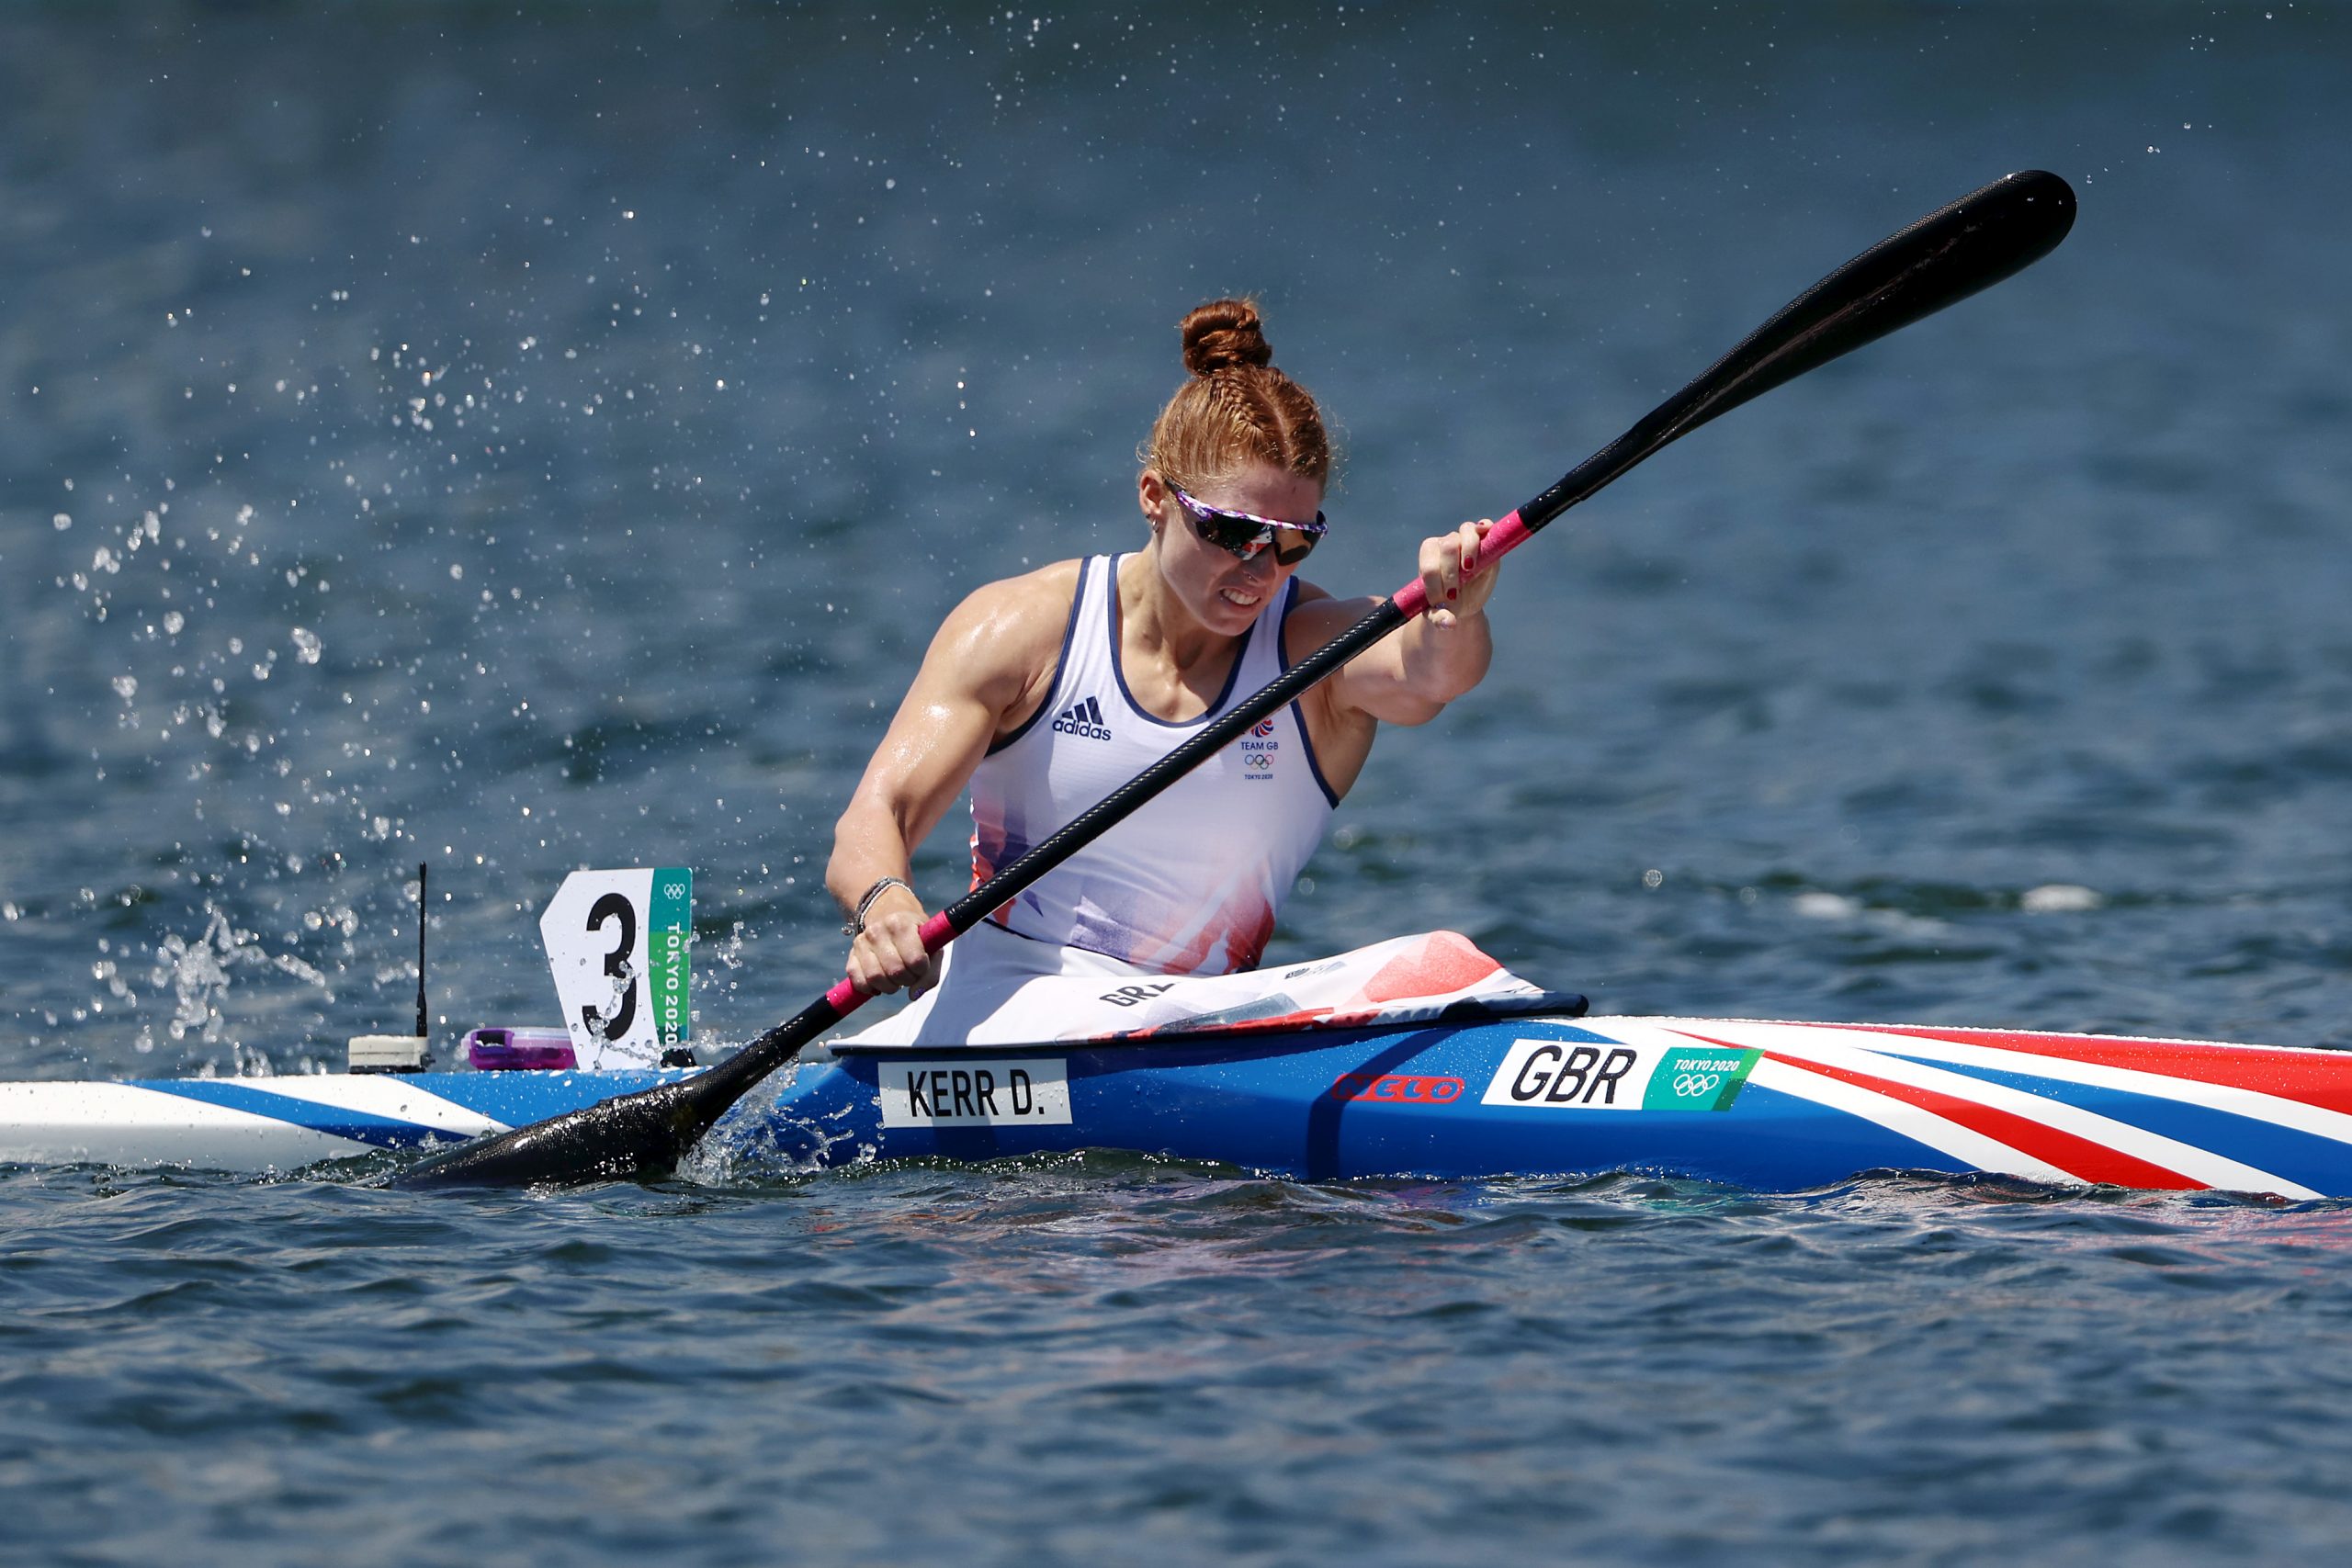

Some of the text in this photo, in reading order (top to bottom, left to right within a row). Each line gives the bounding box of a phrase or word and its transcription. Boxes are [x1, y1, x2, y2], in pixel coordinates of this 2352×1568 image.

[1052, 719, 1112, 741] adidas
[1241, 741, 1279, 750] TEAM GB
[582, 892, 638, 1043] 3
[664, 921, 681, 1044] TOKYO 2020
[1510, 1044, 1638, 1104] GBR
[1673, 1059, 1741, 1072] TOKYO 2020
[907, 1068, 1046, 1118] KERR D.
[1336, 1077, 1460, 1100] NELO
